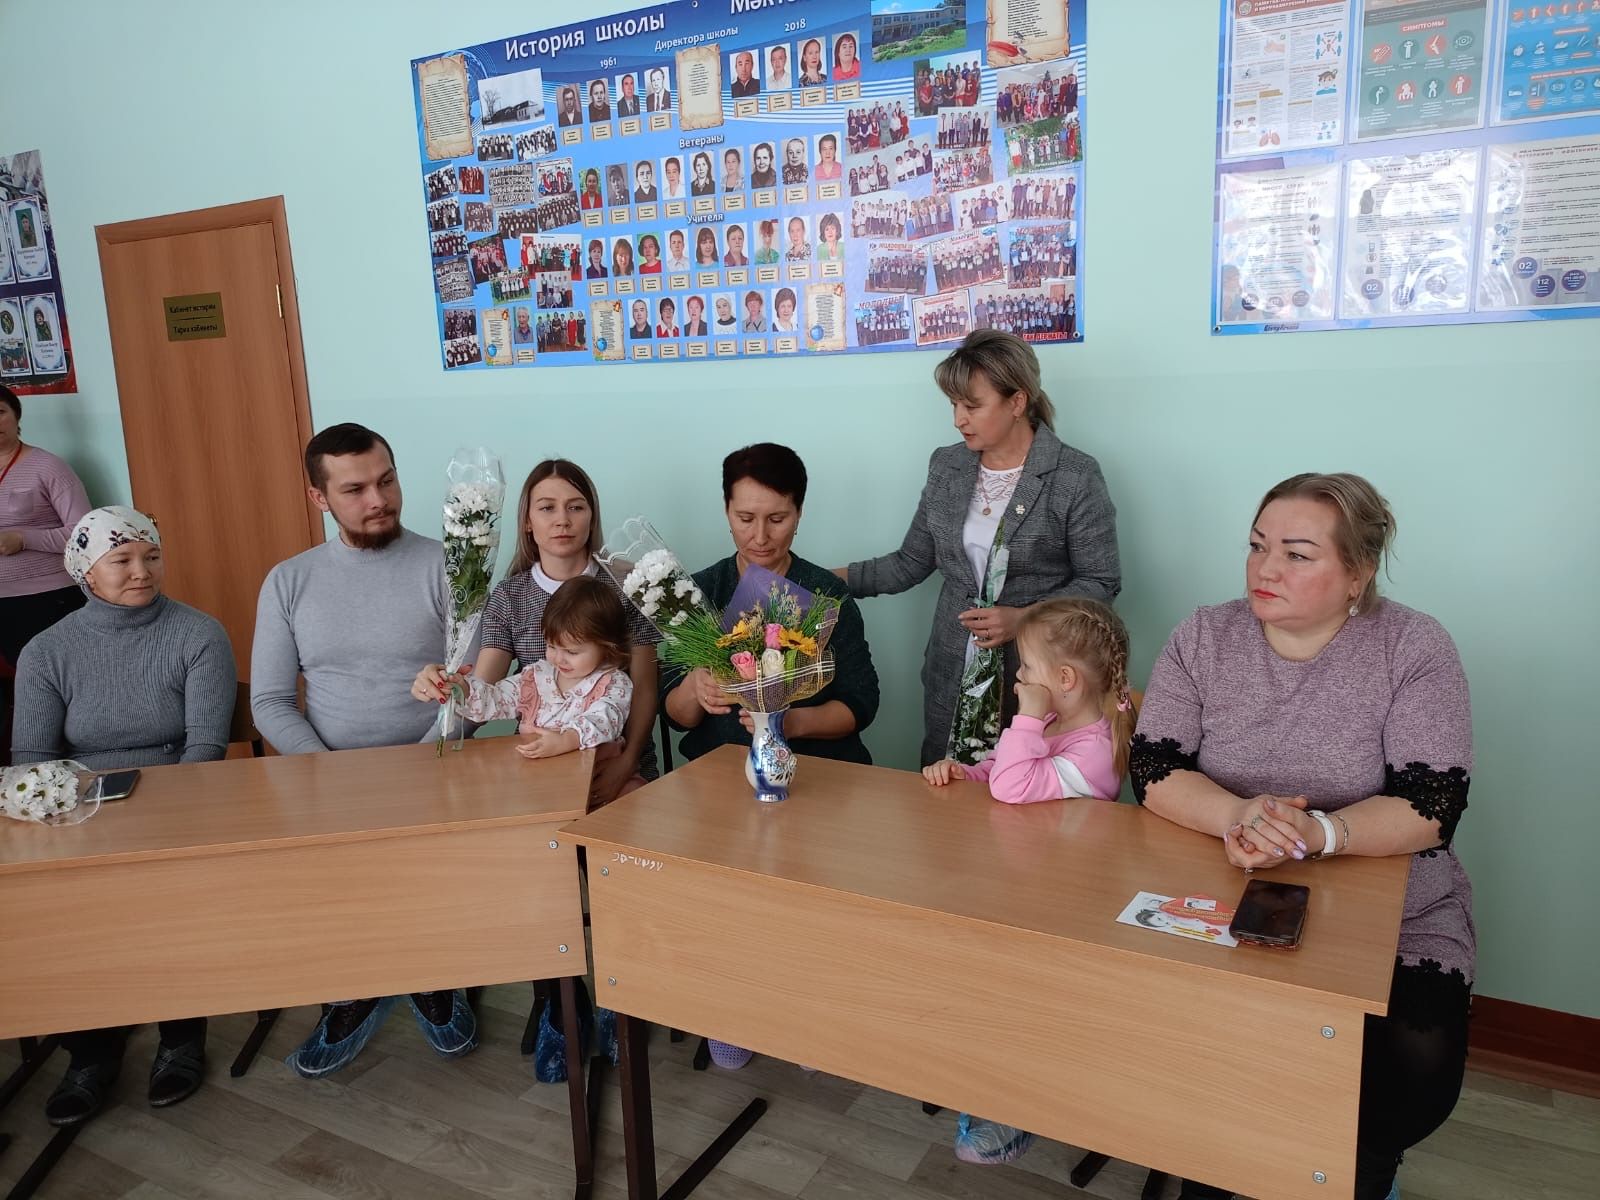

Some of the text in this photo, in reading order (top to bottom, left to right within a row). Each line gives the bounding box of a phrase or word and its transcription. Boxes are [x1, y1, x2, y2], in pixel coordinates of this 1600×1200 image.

[784, 18, 806, 32] 2018
[505, 13, 665, 61] История школы
[654, 26, 739, 52] Директора школы
[599, 58, 617, 68] 1961
[679, 134, 724, 148] Ветераны
[687, 213, 724, 224] Учителя
[1518, 261, 1533, 270] 02
